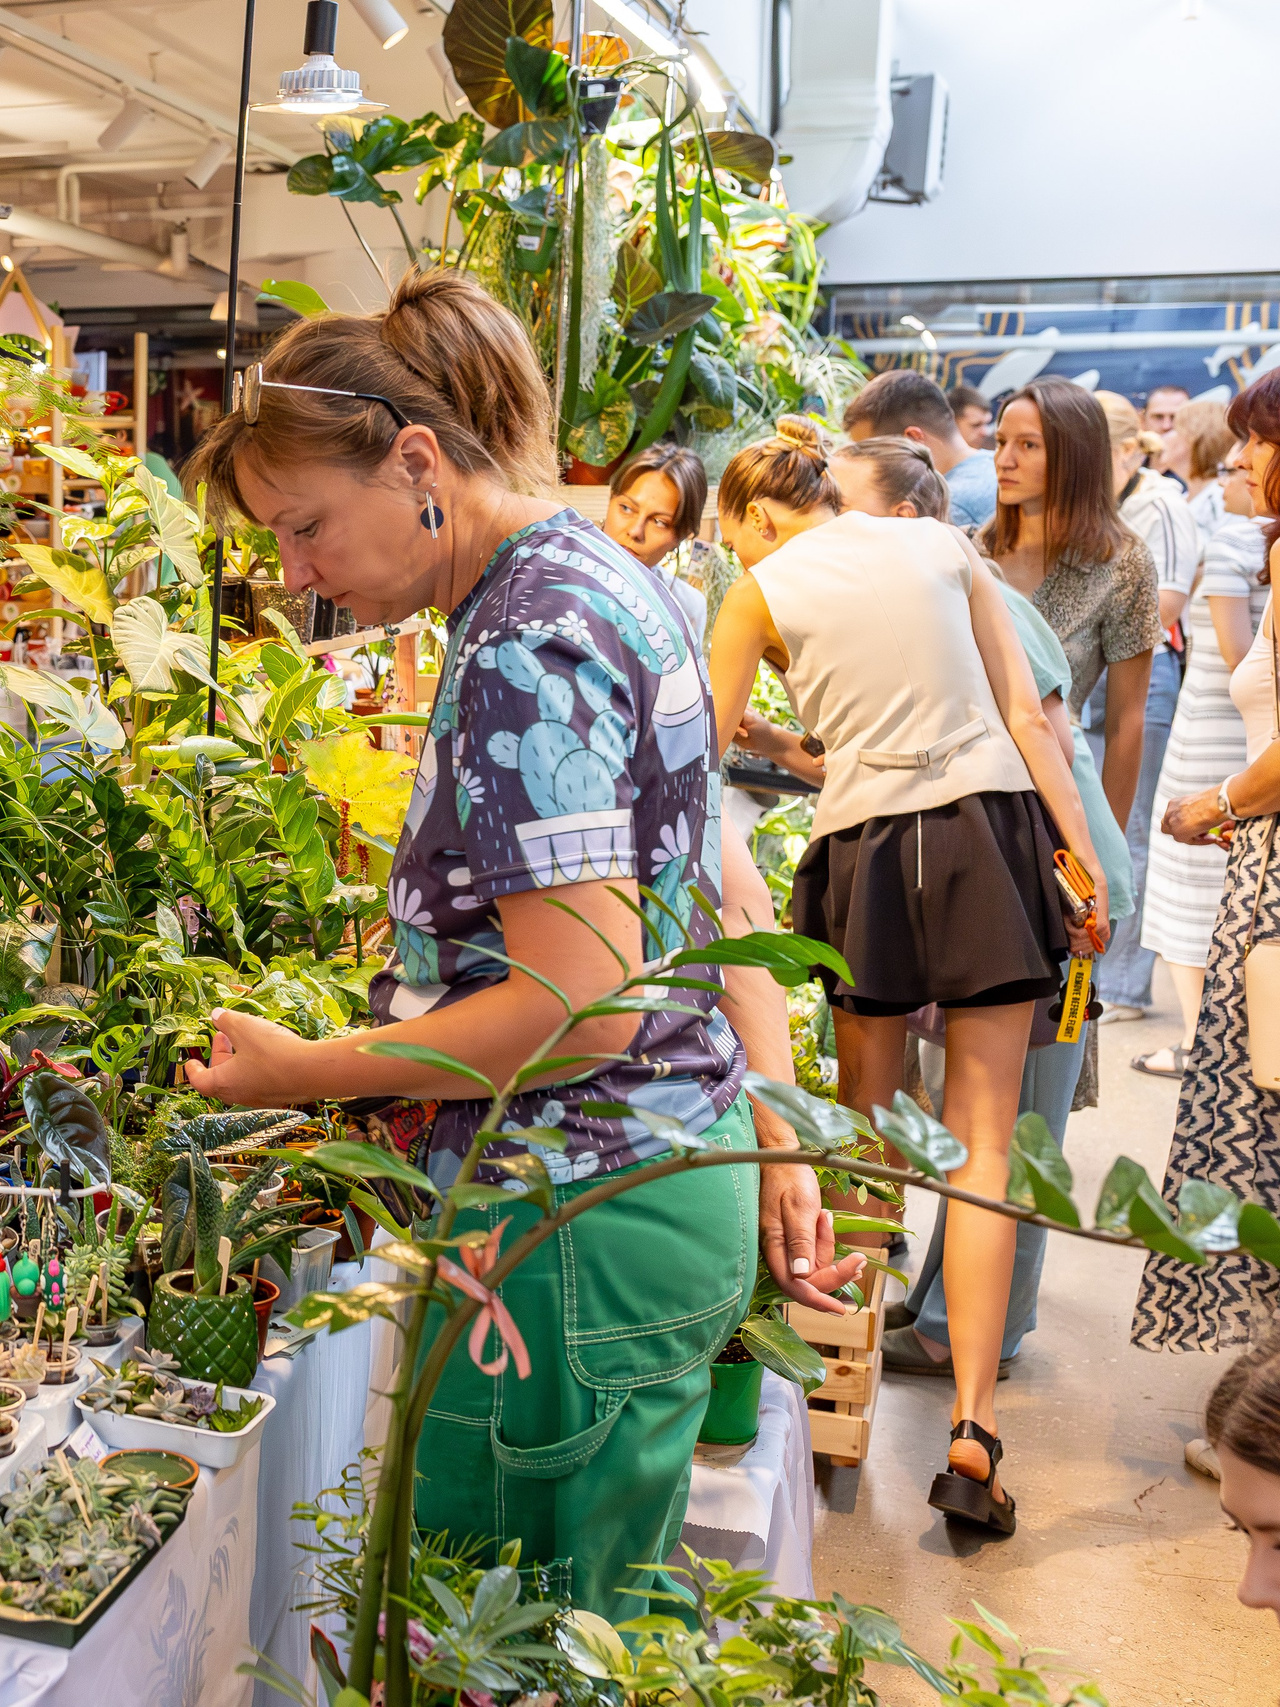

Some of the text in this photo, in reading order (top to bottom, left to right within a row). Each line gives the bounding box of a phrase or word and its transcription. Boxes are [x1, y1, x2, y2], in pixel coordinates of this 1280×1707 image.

[1064, 972, 1084, 1038] REMOVE BEFORE FLIGHT
